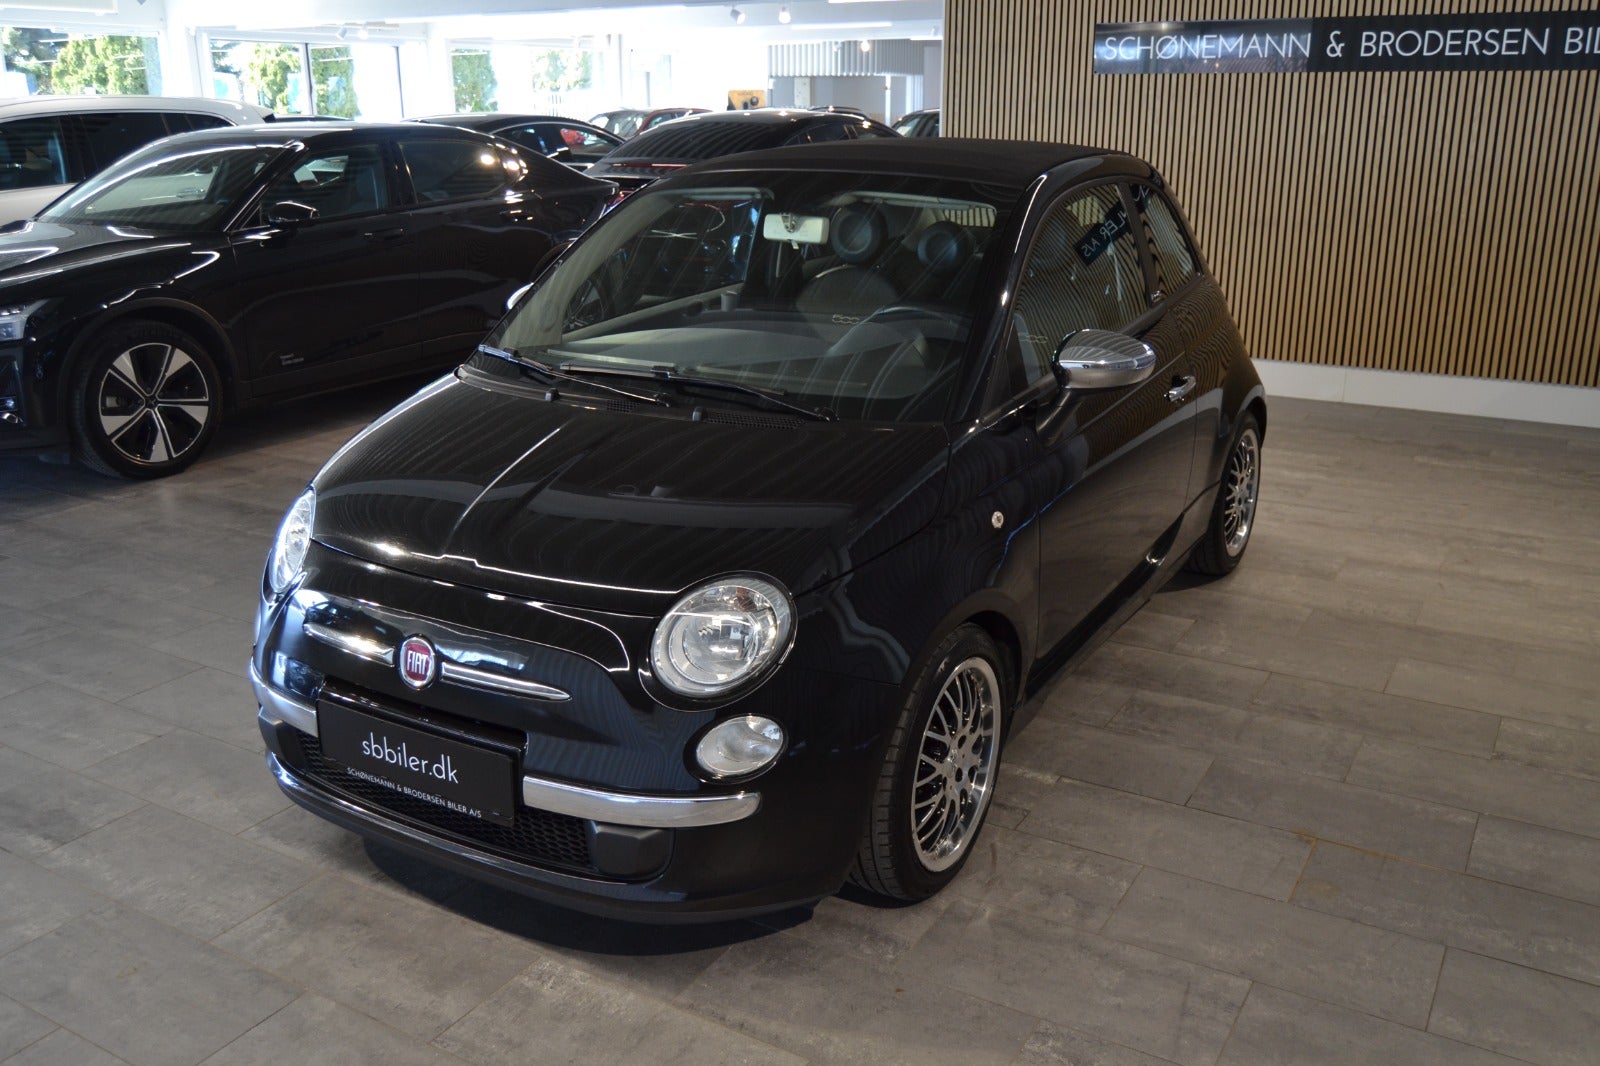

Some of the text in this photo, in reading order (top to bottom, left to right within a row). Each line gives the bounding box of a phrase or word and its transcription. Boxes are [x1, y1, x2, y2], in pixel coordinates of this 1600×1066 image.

[1104, 33, 1311, 60] SCHØNEMANN
[1326, 33, 1345, 58] &
[1360, 27, 1550, 57] BRODERSEN
[406, 650, 428, 675] FIAT
[362, 732, 458, 783] sbbiler.dk
[347, 767, 482, 818] SCHØNEMANN & BRODERSEN BILER A/S
